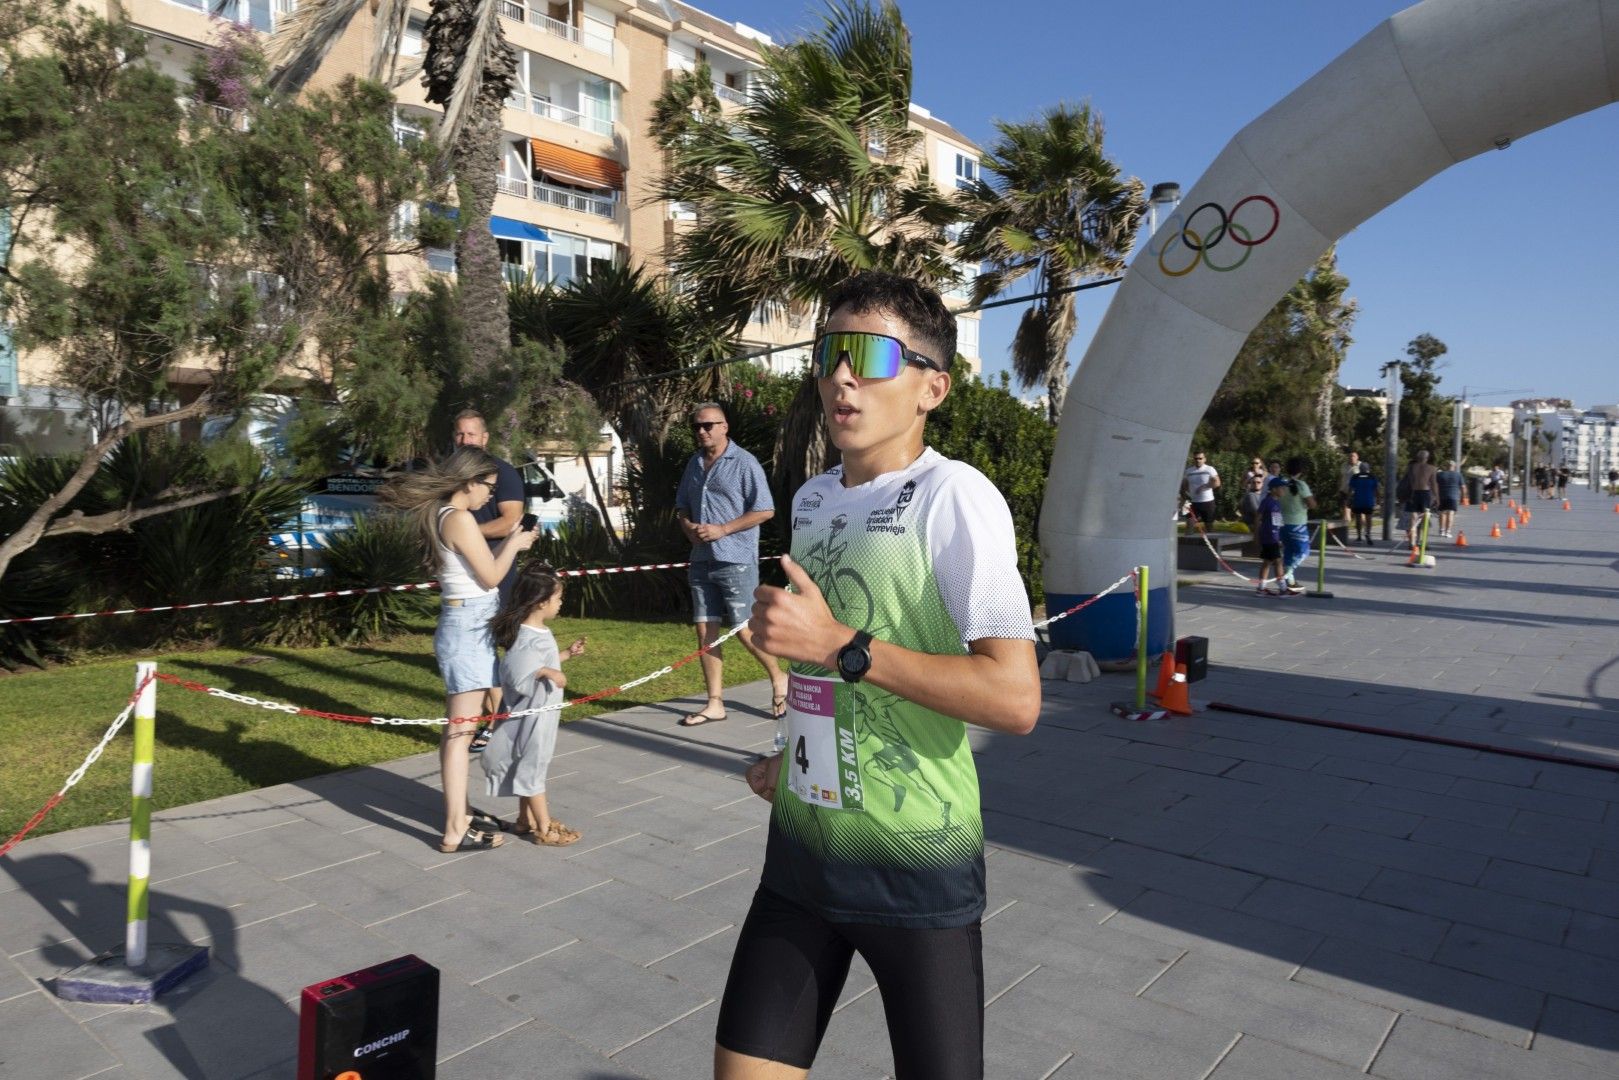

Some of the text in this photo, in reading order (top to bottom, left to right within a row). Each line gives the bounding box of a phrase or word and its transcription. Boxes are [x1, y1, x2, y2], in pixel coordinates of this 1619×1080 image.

[327, 483, 378, 492] BENIDOR
[870, 507, 896, 516] escuela
[866, 524, 906, 536] torrevieja
[795, 735, 809, 775] 4
[839, 727, 862, 801] 3,5 KM
[353, 1029, 410, 1058] CONCHIP
